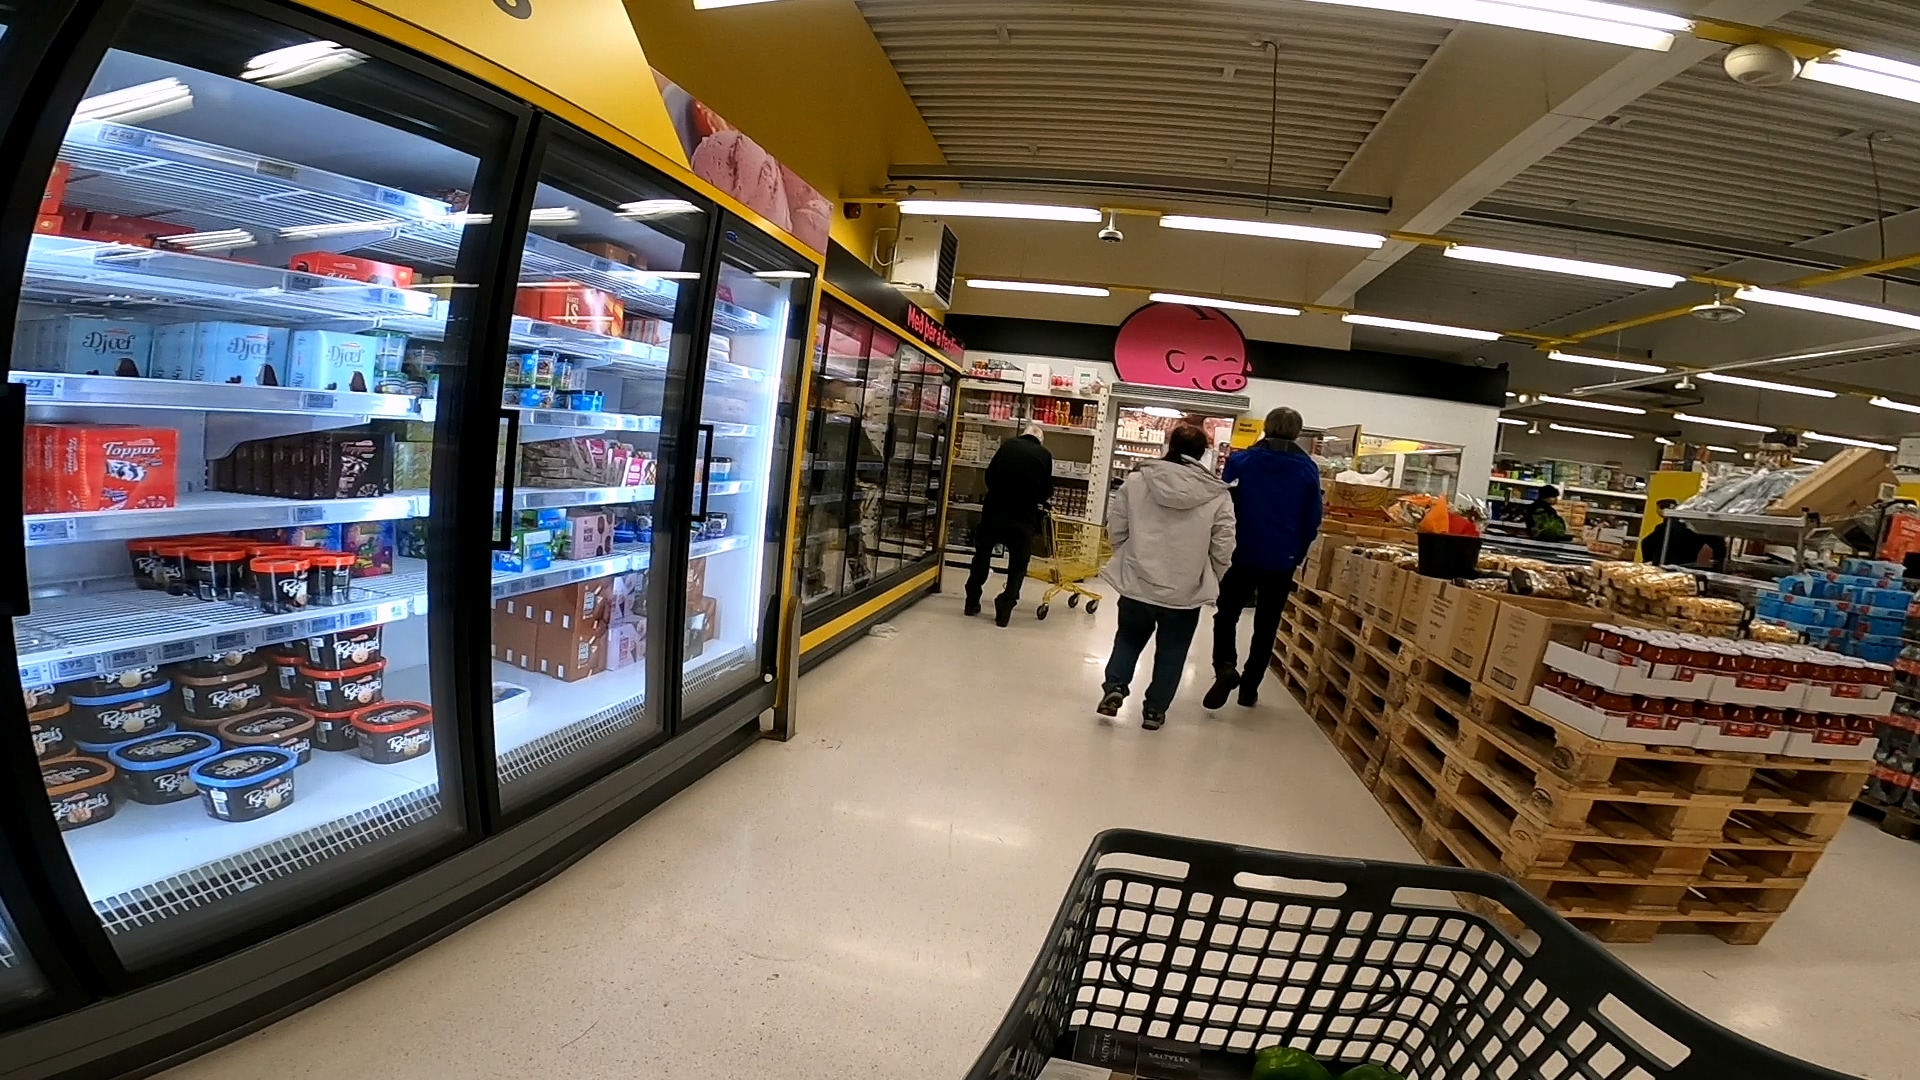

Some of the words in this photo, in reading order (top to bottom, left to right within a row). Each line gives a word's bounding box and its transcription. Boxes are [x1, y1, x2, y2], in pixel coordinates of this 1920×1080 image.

[907, 303, 924, 334] Með
[82, 331, 136, 355] Djæf
[227, 337, 275, 361] Djæf
[327, 345, 365, 368] Djæf
[102, 441, 161, 458] Toppur
